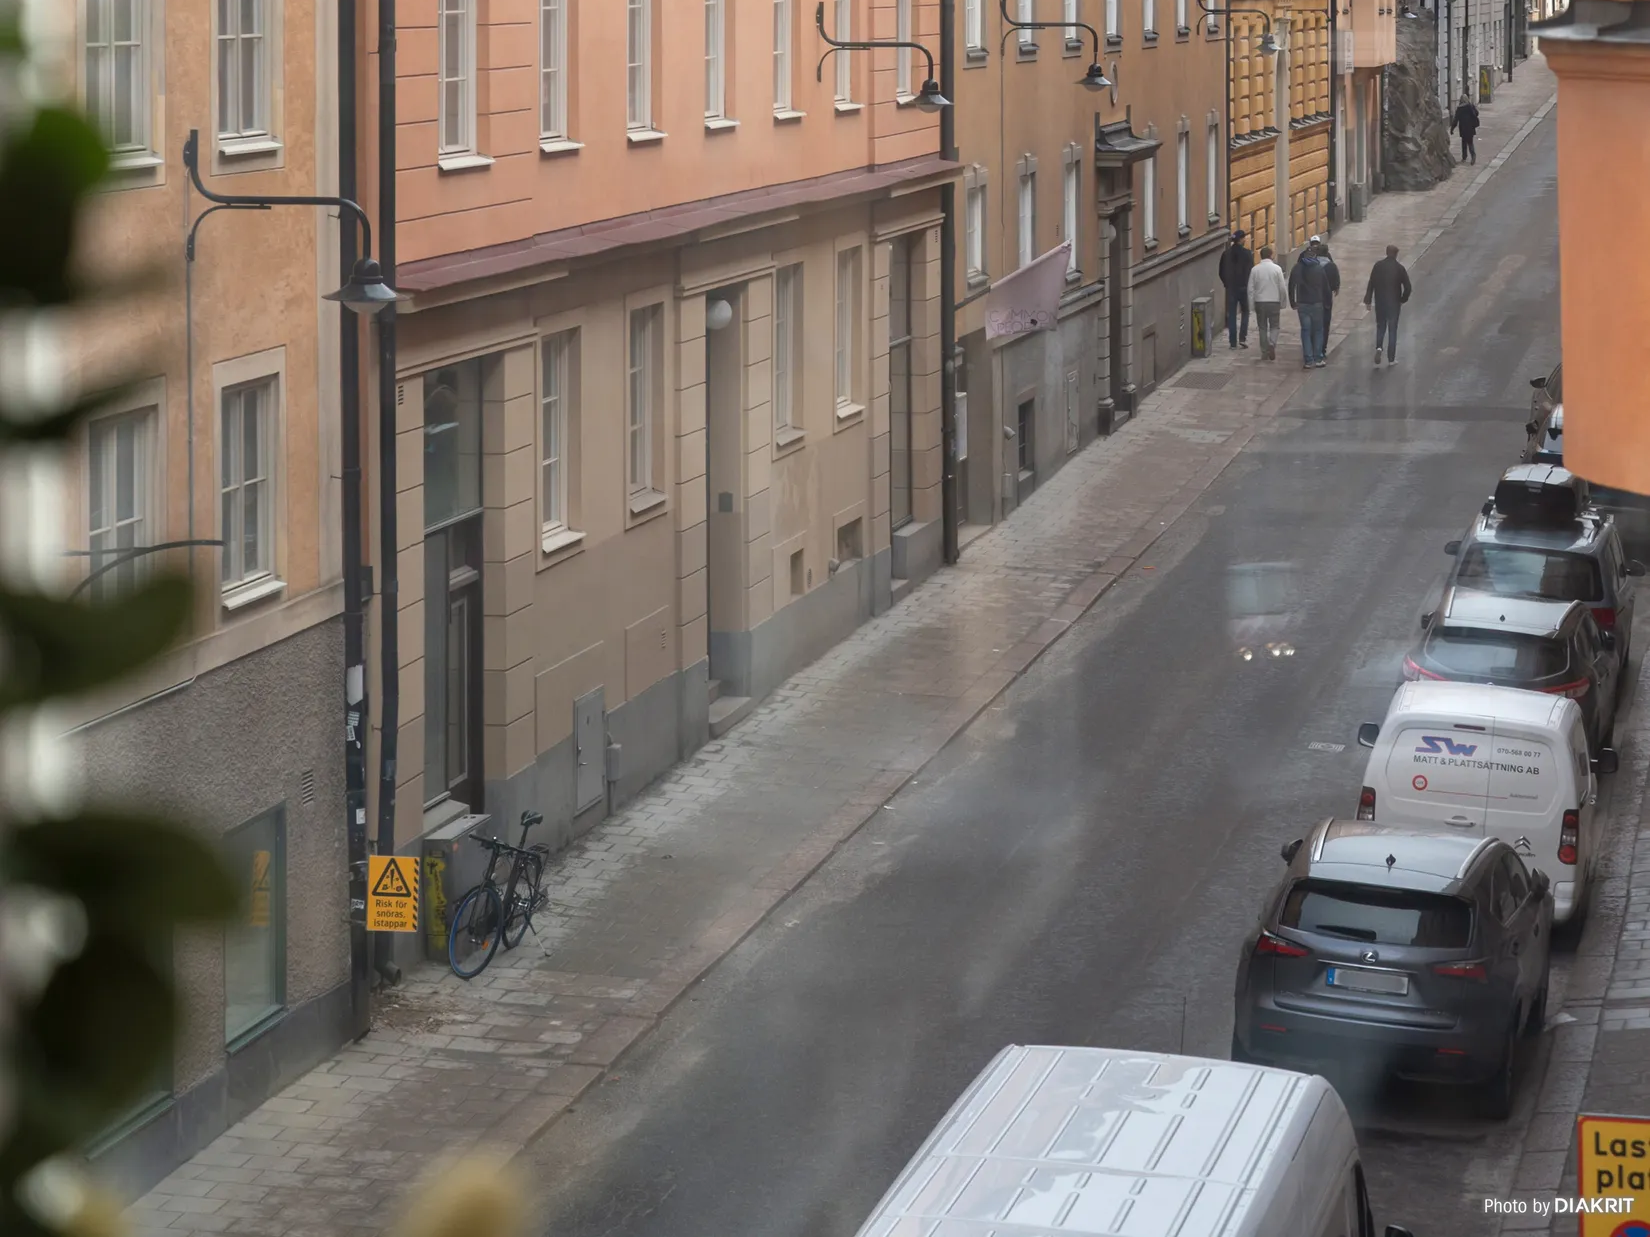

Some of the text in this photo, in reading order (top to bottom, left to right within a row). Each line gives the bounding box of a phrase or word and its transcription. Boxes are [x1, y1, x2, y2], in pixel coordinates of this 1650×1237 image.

[989, 308, 1057, 322] CMMON
[1415, 736, 1478, 757] SW
[1413, 754, 1439, 765] MATT
[1440, 757, 1447, 765] &
[1526, 766, 1540, 775] AB
[375, 899, 393, 908] Risk
[1595, 1131, 1650, 1158] Las
[1597, 1164, 1650, 1194] pla
